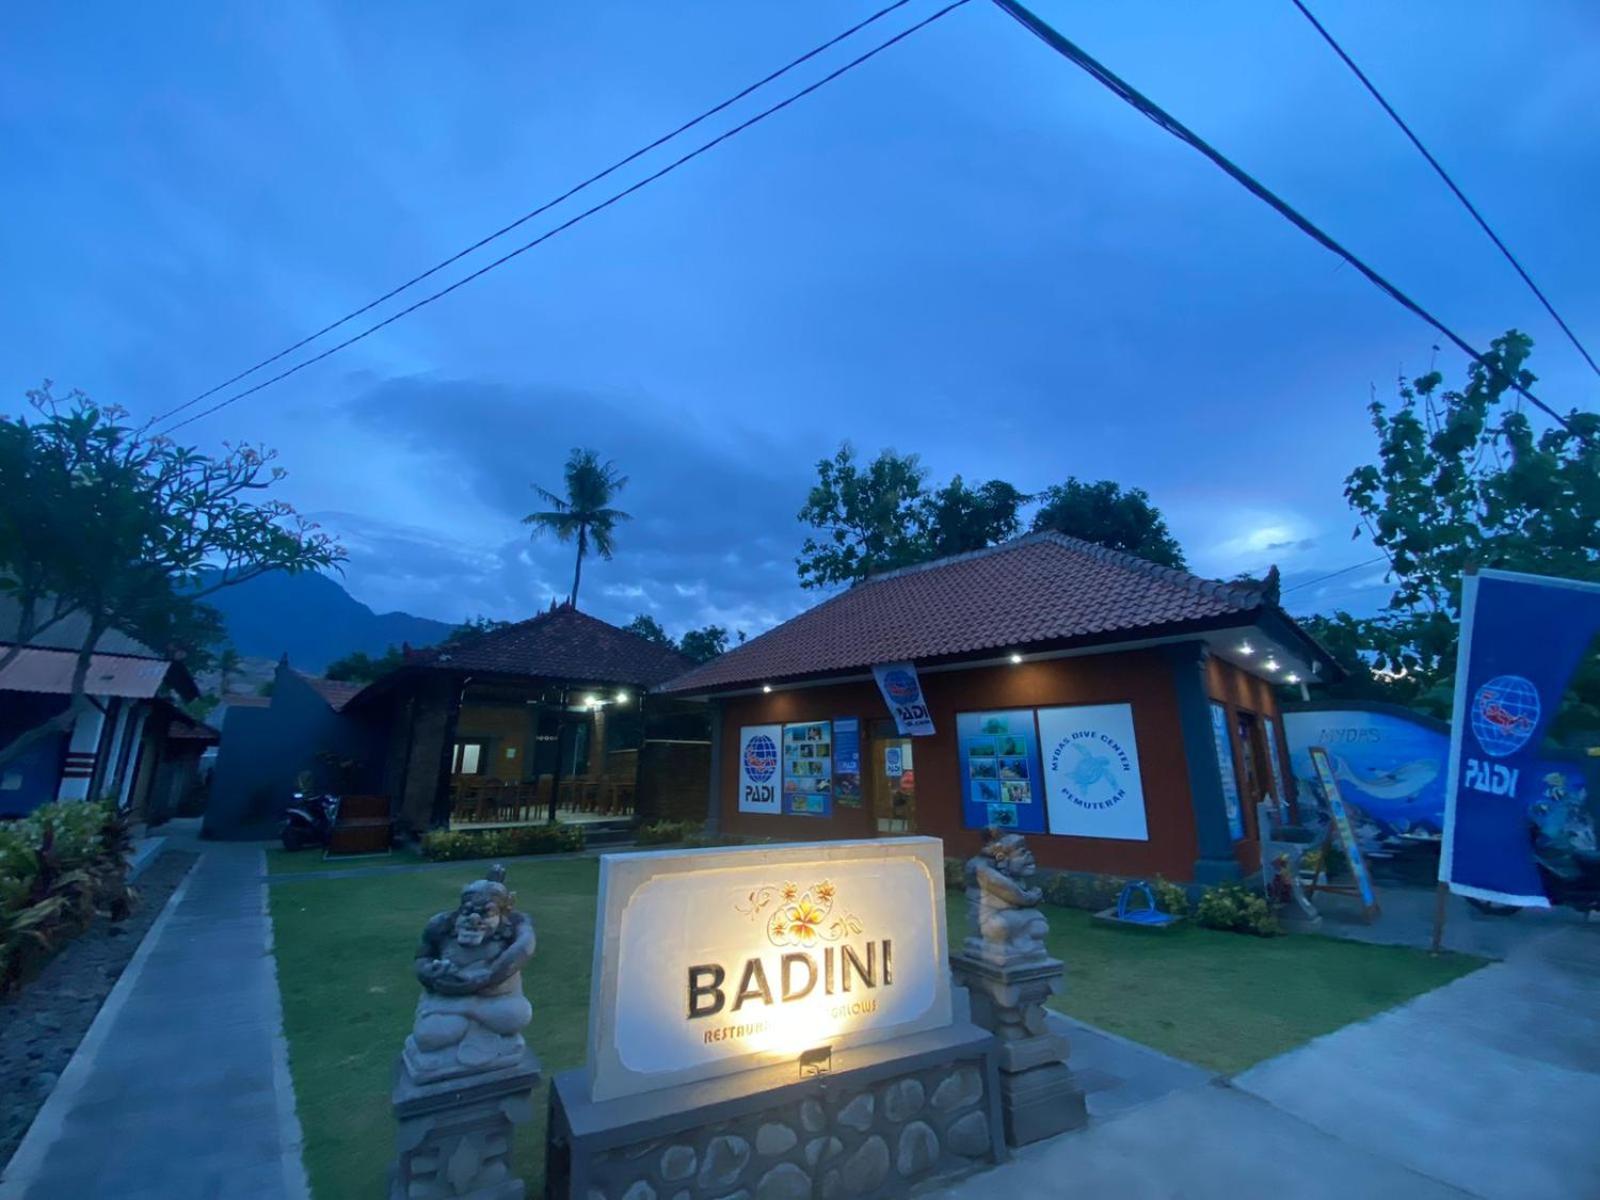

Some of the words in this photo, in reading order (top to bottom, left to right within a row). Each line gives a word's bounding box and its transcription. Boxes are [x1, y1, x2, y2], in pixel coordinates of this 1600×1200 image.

[1052, 736, 1070, 771] MYDAS
[1071, 730, 1096, 740] DIVE
[1100, 734, 1130, 771] CENTER
[745, 785, 775, 804] PADI
[1463, 758, 1520, 798] PADI
[1062, 788, 1126, 809] PEMUTERAN
[687, 939, 894, 1020] BADINI
